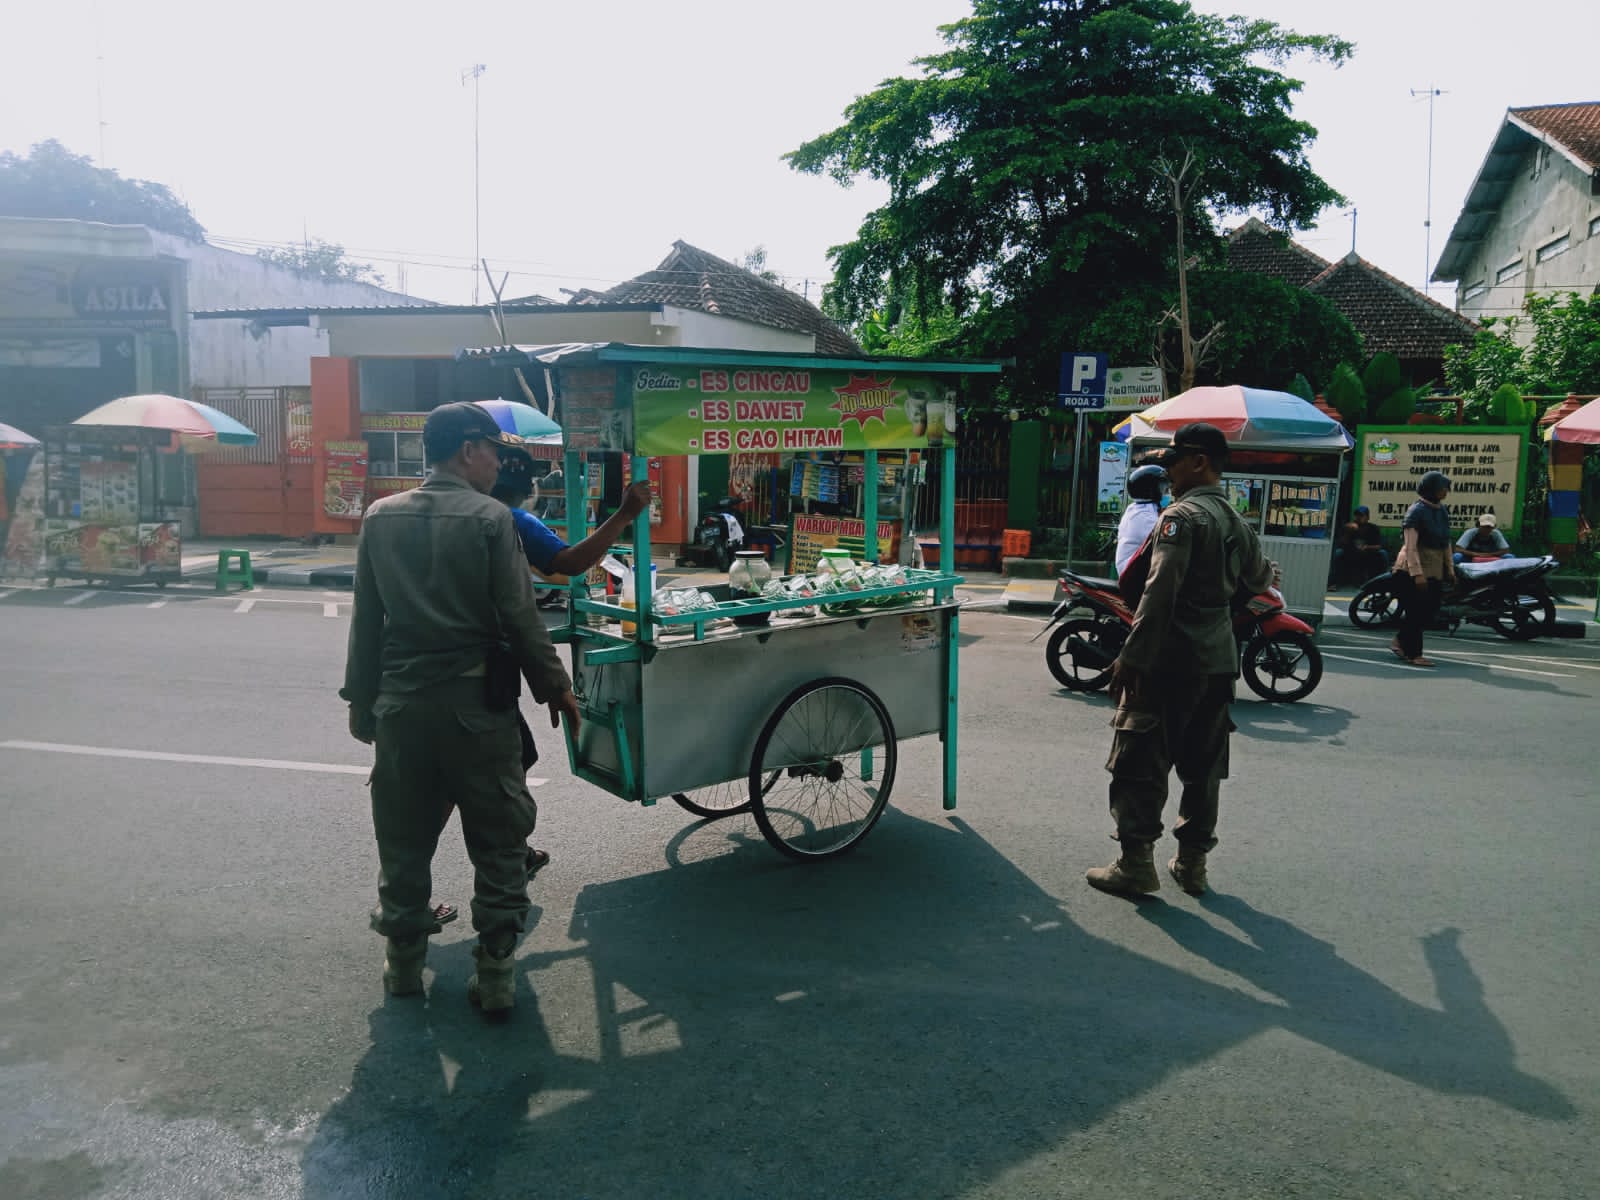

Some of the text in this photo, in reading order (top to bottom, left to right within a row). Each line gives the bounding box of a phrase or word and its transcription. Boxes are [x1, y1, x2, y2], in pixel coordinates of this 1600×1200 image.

[85, 287, 167, 312] ASILA
[637, 370, 680, 391] Sedia:
[701, 370, 729, 392] ES
[734, 370, 810, 392] CINCAU
[1072, 356, 1097, 391] P
[702, 400, 731, 422] ES
[735, 400, 806, 422] DAWET
[840, 388, 891, 413] Rp 4000
[1064, 397, 1090, 406] RODA
[1091, 397, 1098, 407] 2
[703, 430, 731, 451] ES
[736, 430, 779, 450] CAO
[783, 428, 844, 449] HITAM
[1408, 443, 1501, 453] YAYASAN KARTIKA JAYA
[1453, 467, 1495, 477] BRAWIJAYA
[1368, 481, 1395, 492] TAMAN
[1454, 482, 1486, 493] KARTIKA
[796, 517, 837, 533] WARKOP
